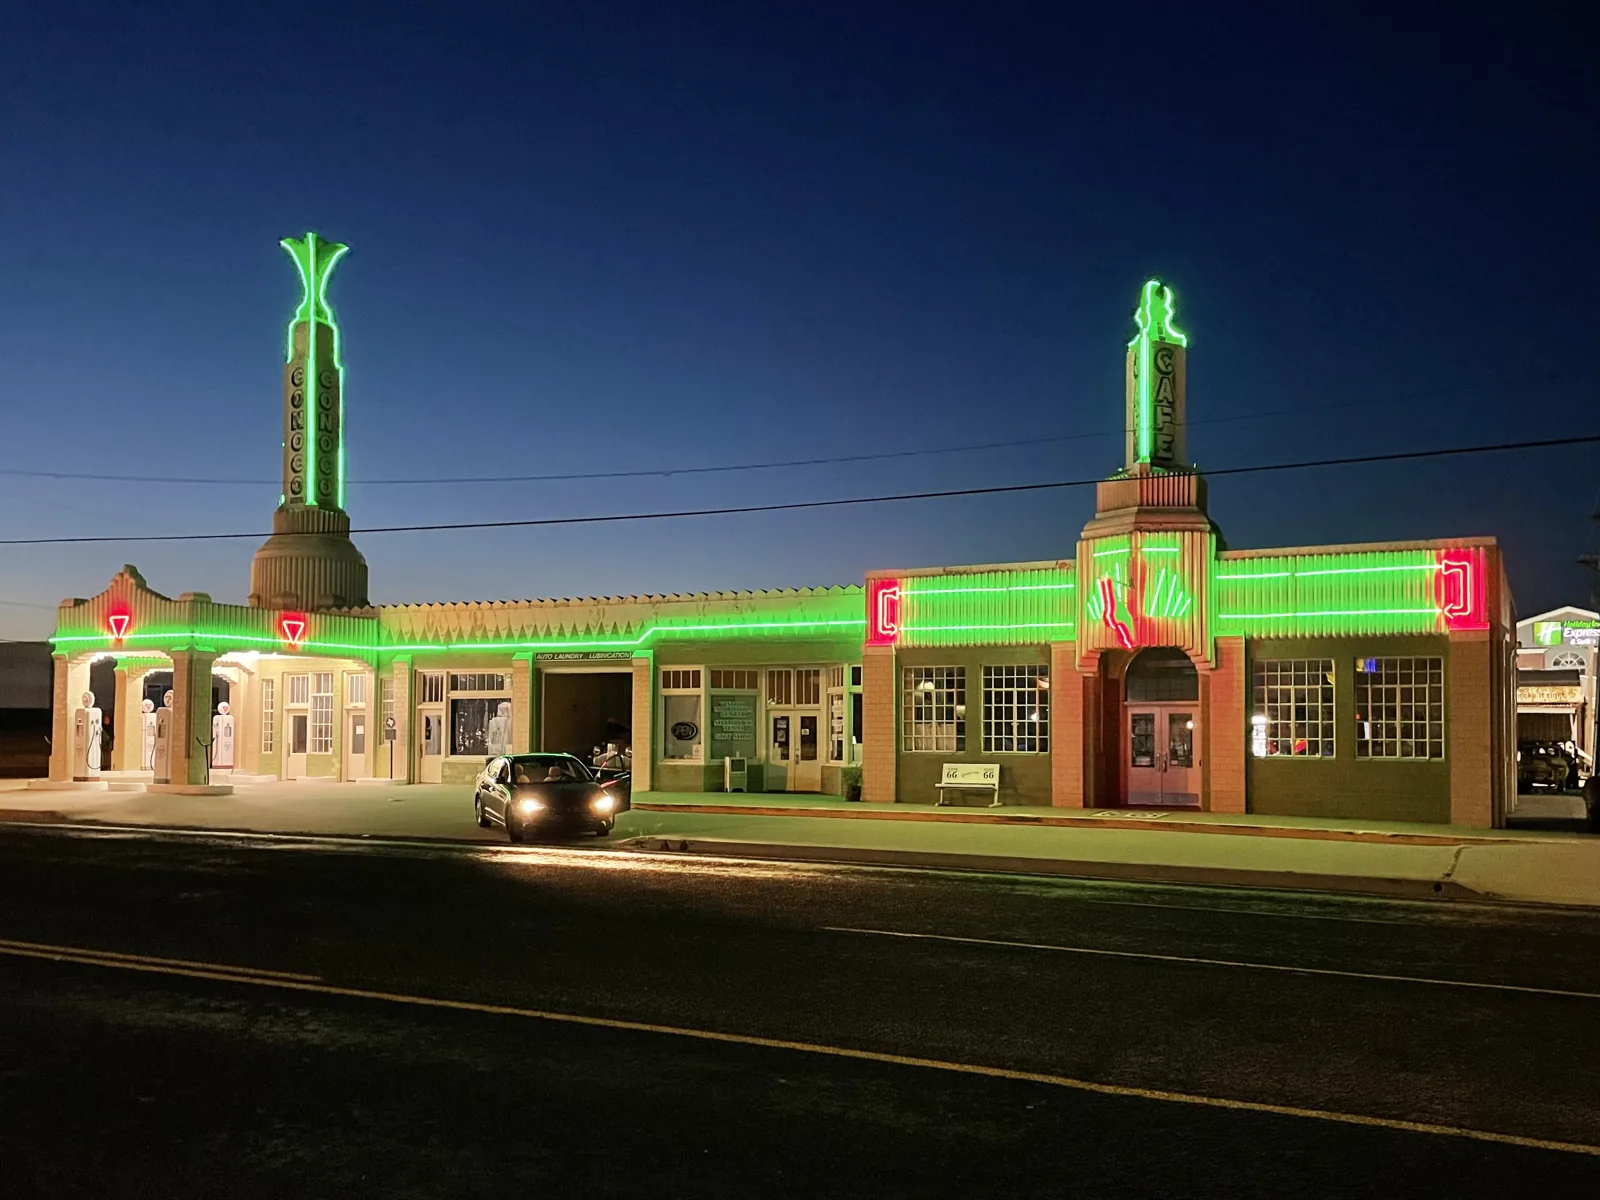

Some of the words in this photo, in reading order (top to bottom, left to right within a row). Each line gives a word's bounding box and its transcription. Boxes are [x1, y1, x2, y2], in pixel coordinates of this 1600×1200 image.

[290, 367, 304, 496] CONOCO
[318, 369, 333, 497] CONOCO
[1153, 347, 1175, 461] CAFE
[1564, 620, 1591, 629] Holiday
[946, 771, 957, 779] 66
[983, 771, 994, 779] 66
